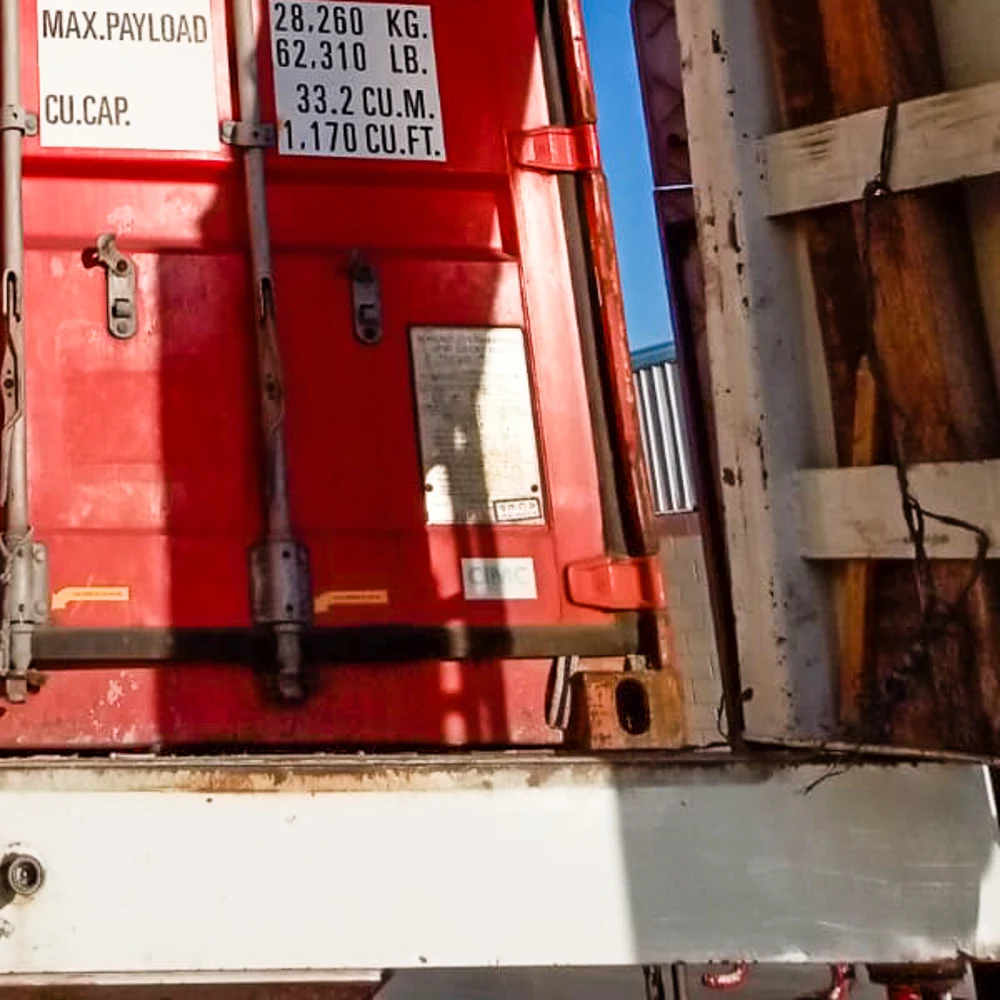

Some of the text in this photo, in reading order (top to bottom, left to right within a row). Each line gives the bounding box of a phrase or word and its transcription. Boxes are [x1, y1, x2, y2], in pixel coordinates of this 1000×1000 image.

[42, 9, 208, 44] MAX.PAYLOAD
[386, 9, 429, 40] KG.
[390, 44, 428, 75] LB.
[44, 94, 132, 127] CU.CAP.
[296, 83, 436, 120] 33.2 CU.M.
[366, 123, 442, 157] CU.FT.
